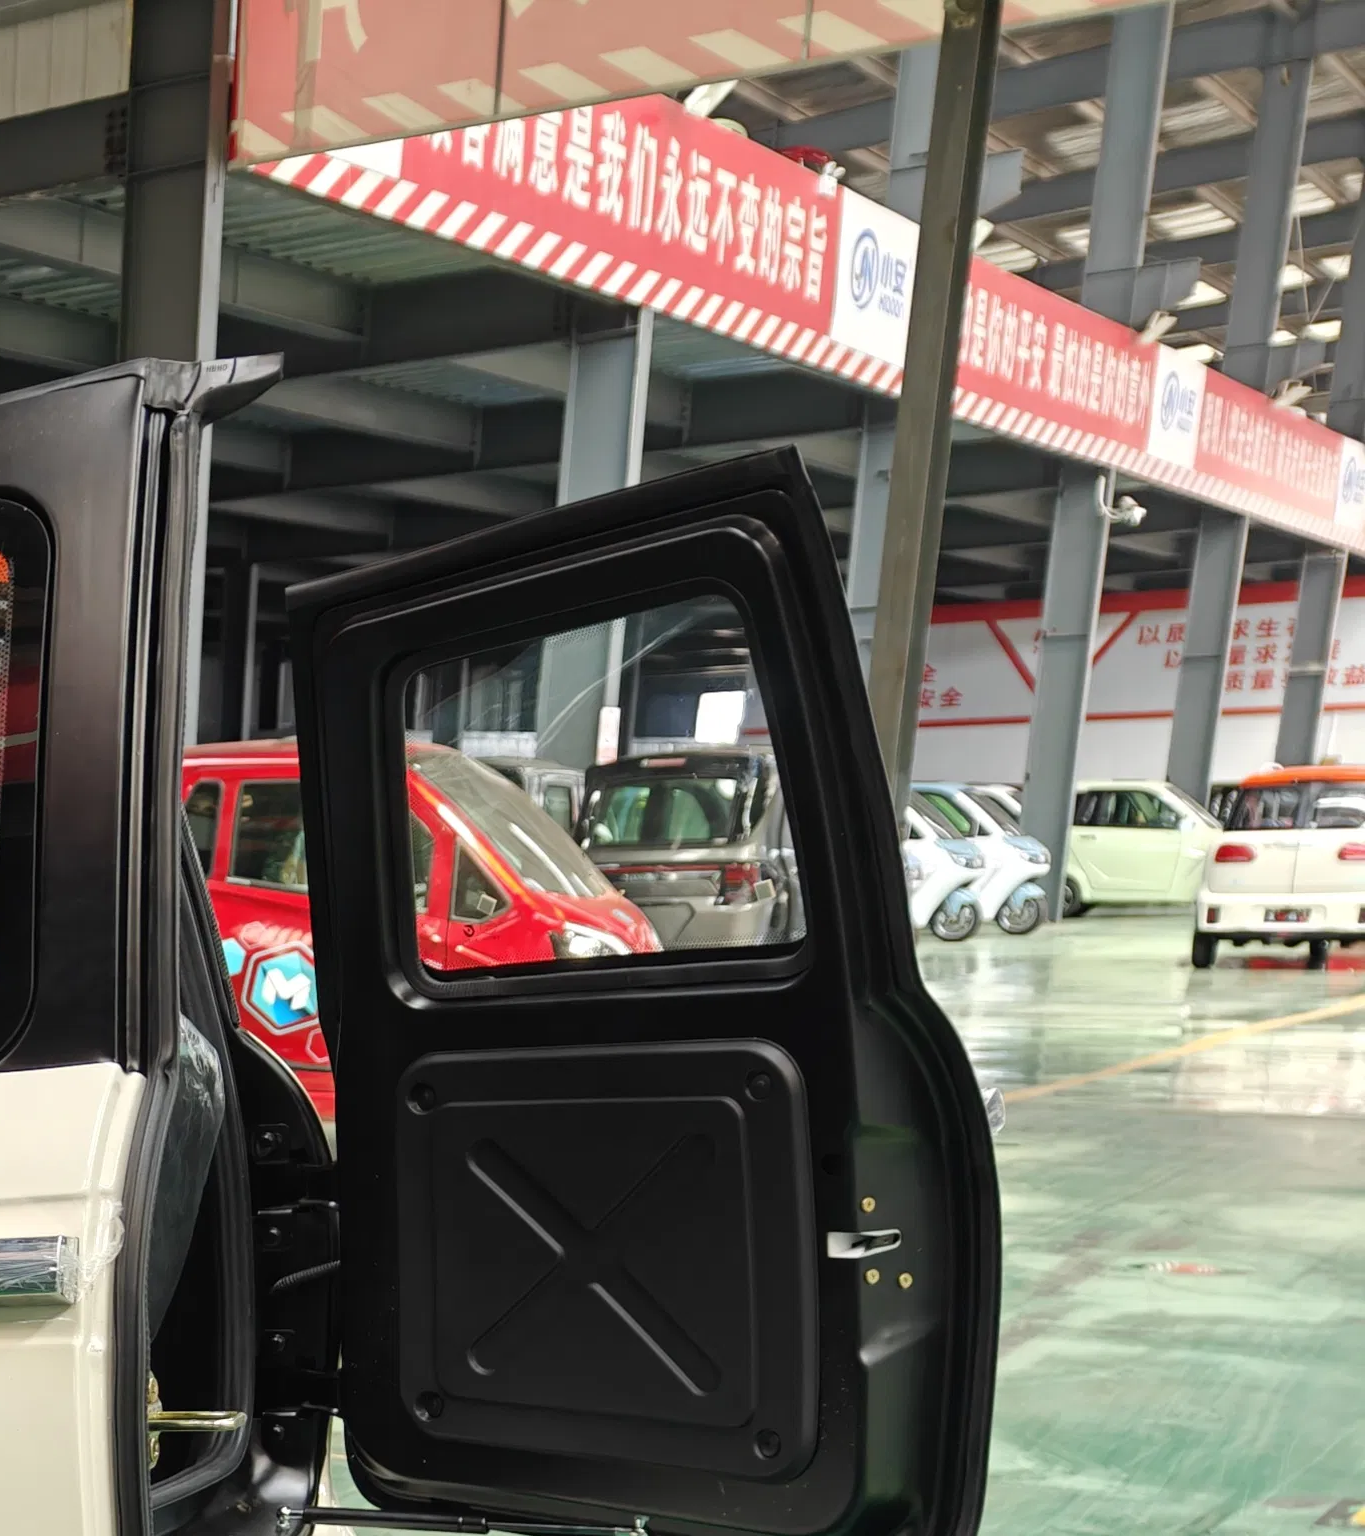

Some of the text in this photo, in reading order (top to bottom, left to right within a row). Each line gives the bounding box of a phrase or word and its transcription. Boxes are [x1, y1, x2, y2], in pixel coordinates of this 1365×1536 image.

[422, 104, 829, 303] 满意是我们永远不变的宗旨
